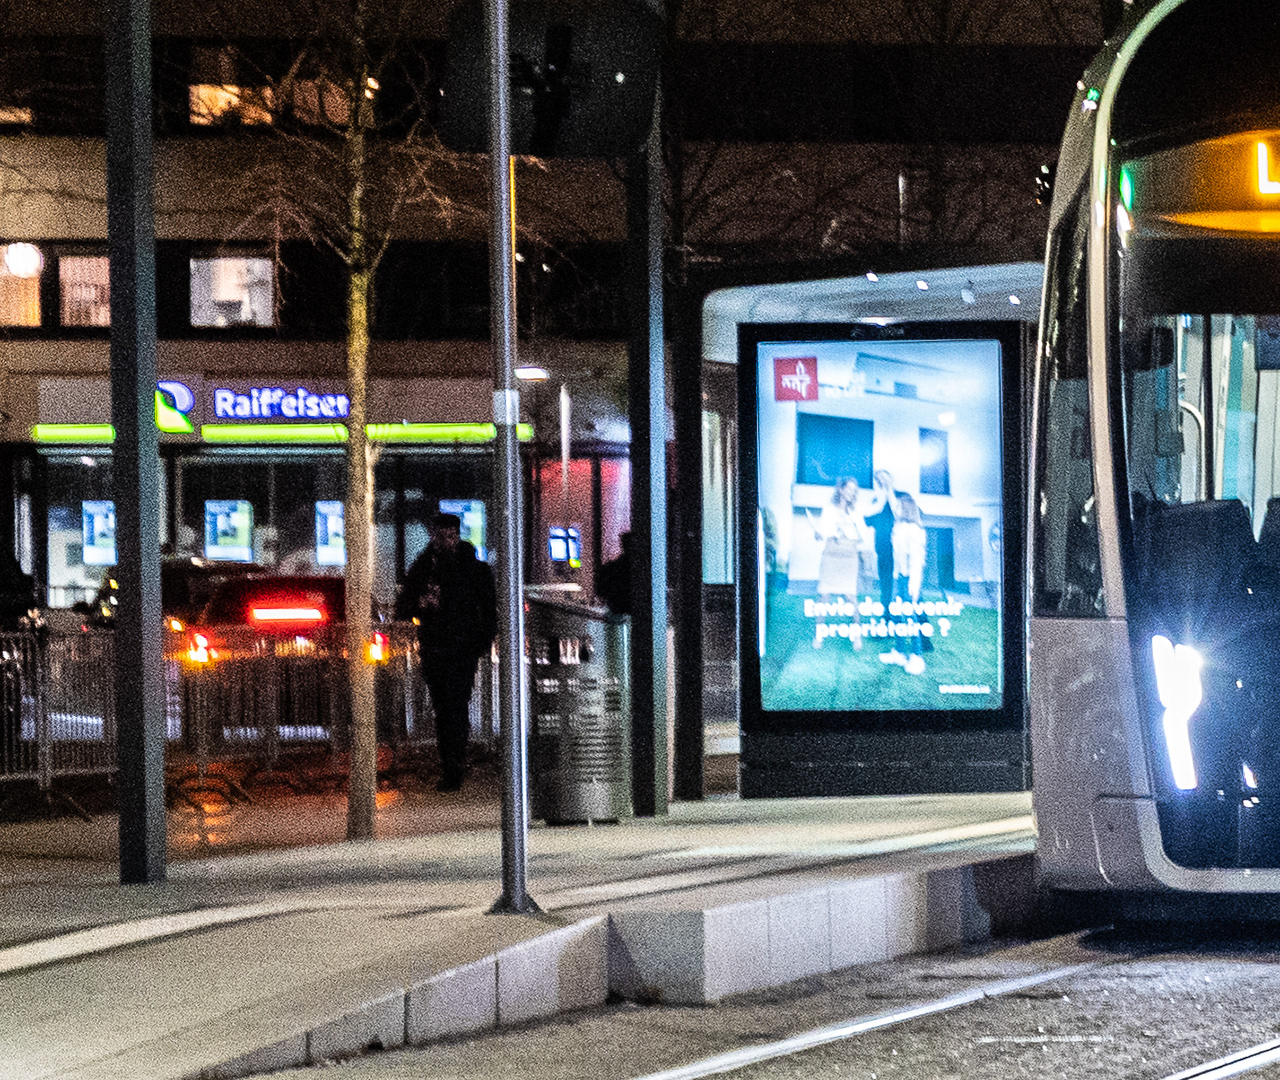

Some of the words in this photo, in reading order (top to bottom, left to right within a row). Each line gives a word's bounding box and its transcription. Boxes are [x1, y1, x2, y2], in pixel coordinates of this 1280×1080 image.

[804, 597, 855, 617] Envie
[858, 596, 885, 616] de
[889, 596, 964, 616] devenir
[815, 618, 935, 643] propriétaire
